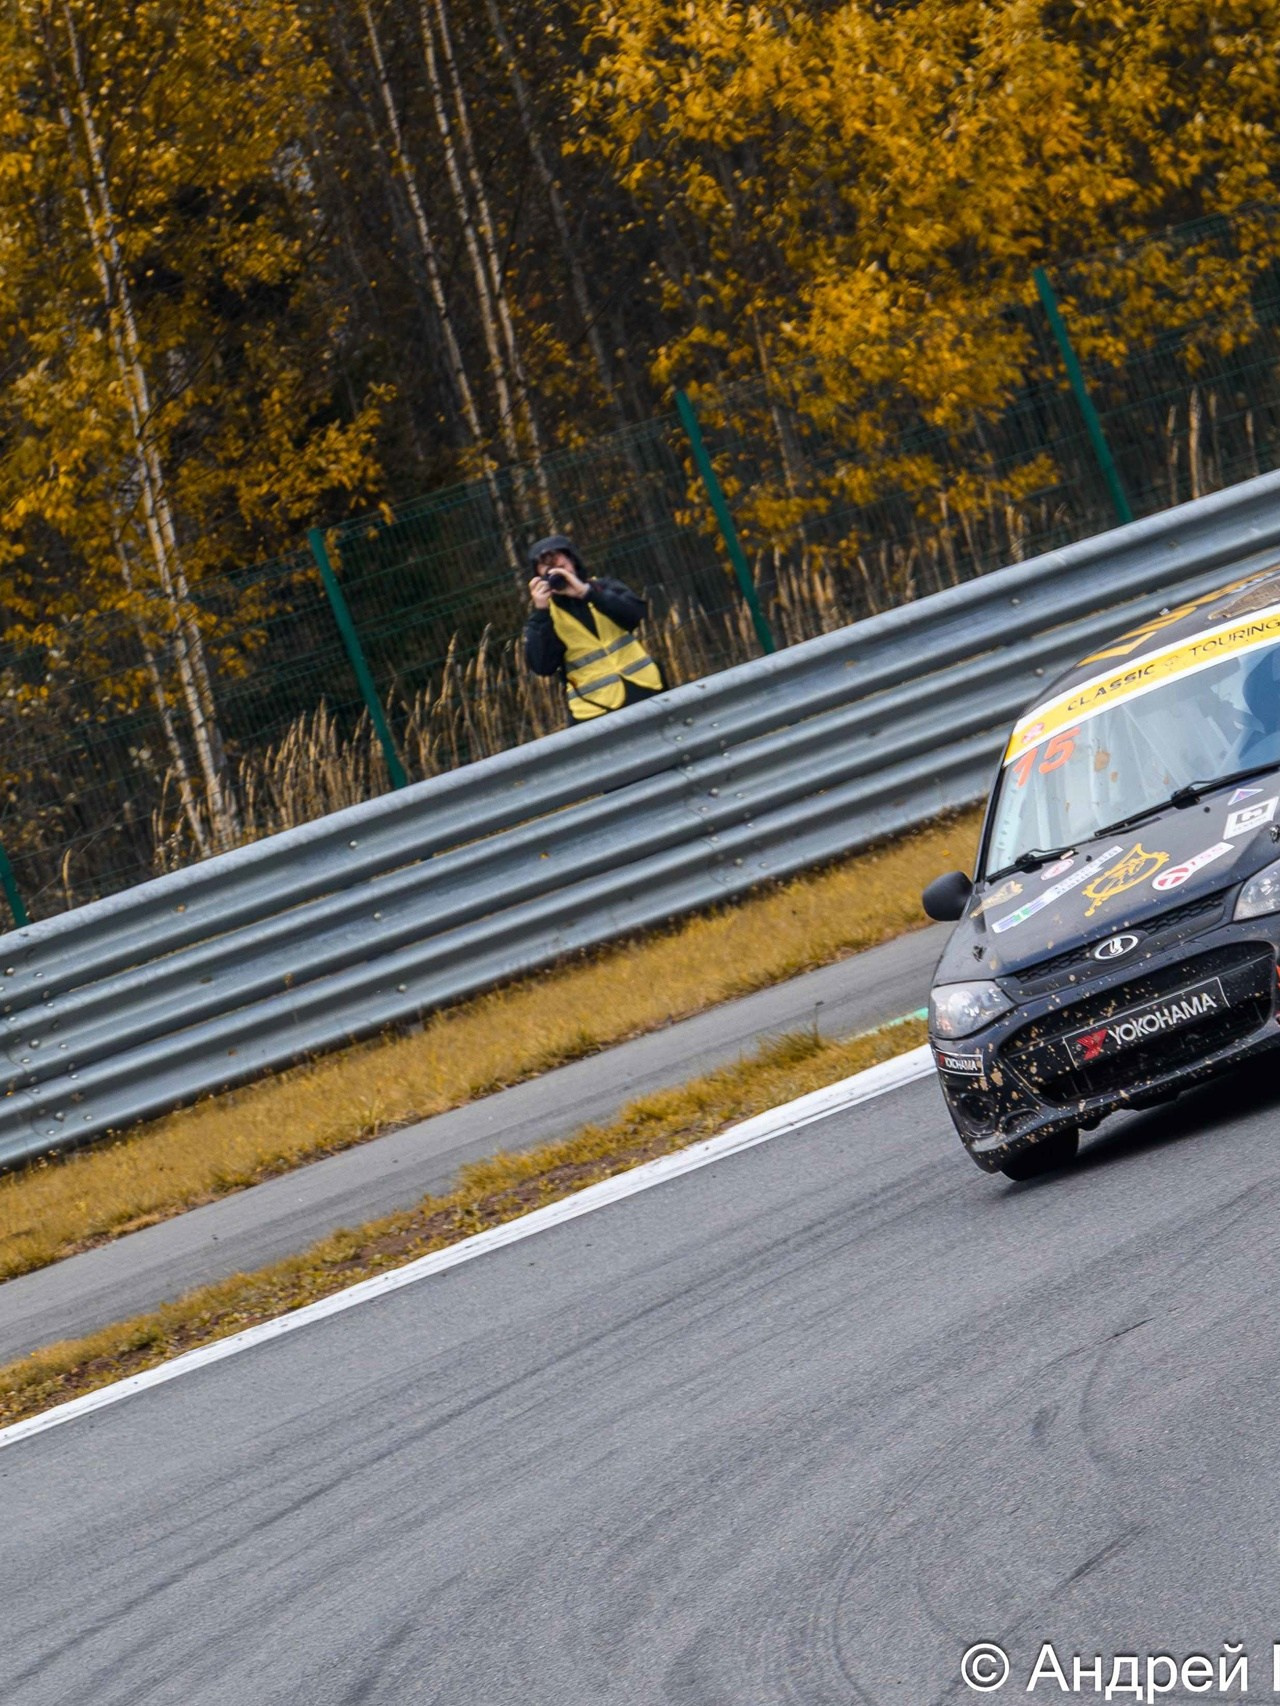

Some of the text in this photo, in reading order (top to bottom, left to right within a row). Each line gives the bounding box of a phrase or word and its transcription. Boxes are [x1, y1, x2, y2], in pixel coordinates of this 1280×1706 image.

[1067, 663, 1155, 712] CLASSIC
[1013, 726, 1081, 789] 15
[1108, 992, 1218, 1045] YOKOHAMA
